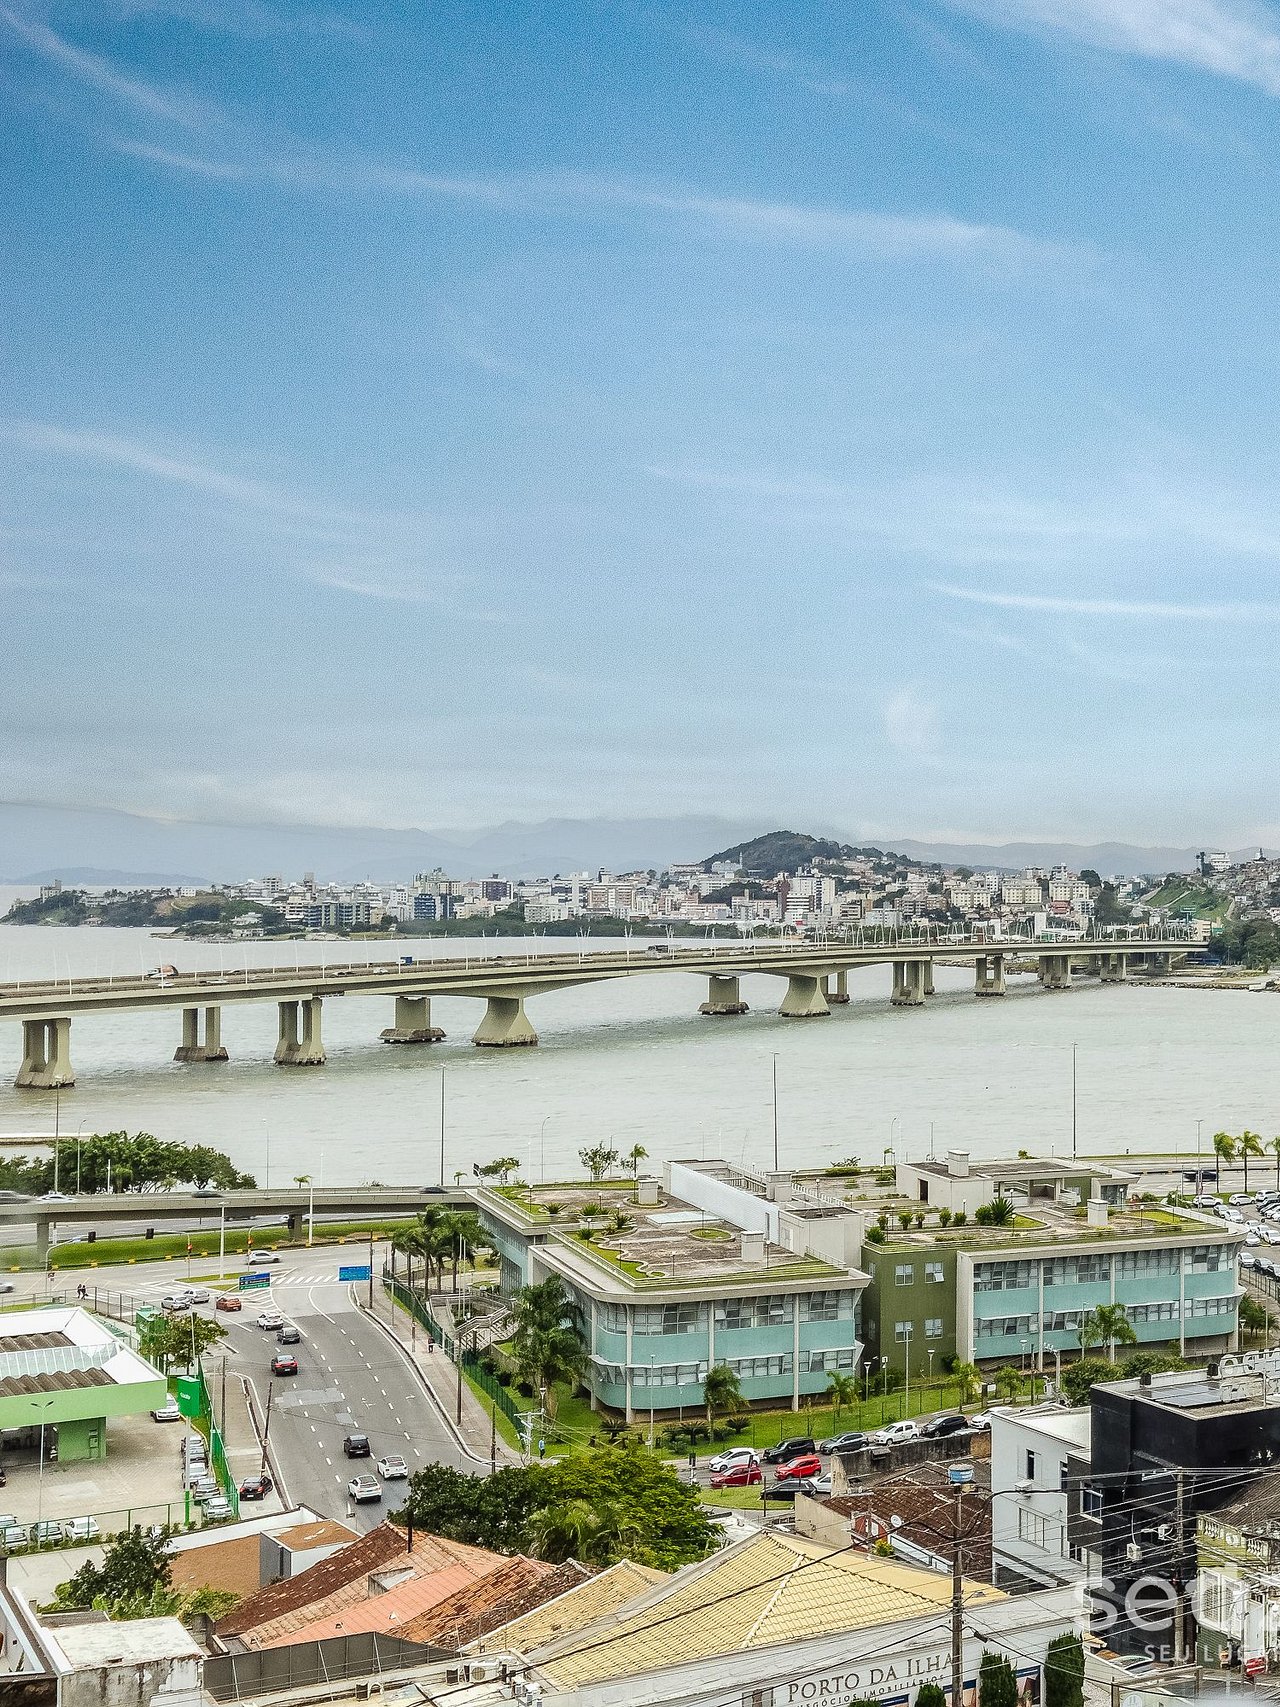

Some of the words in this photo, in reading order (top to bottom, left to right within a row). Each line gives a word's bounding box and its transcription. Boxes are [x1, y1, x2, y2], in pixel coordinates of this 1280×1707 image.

[787, 1672, 860, 1703] PORTO
[869, 1665, 898, 1686] DA
[906, 1652, 953, 1678] ILHA
[863, 1674, 944, 1698] IMOBILIÁRIOS
